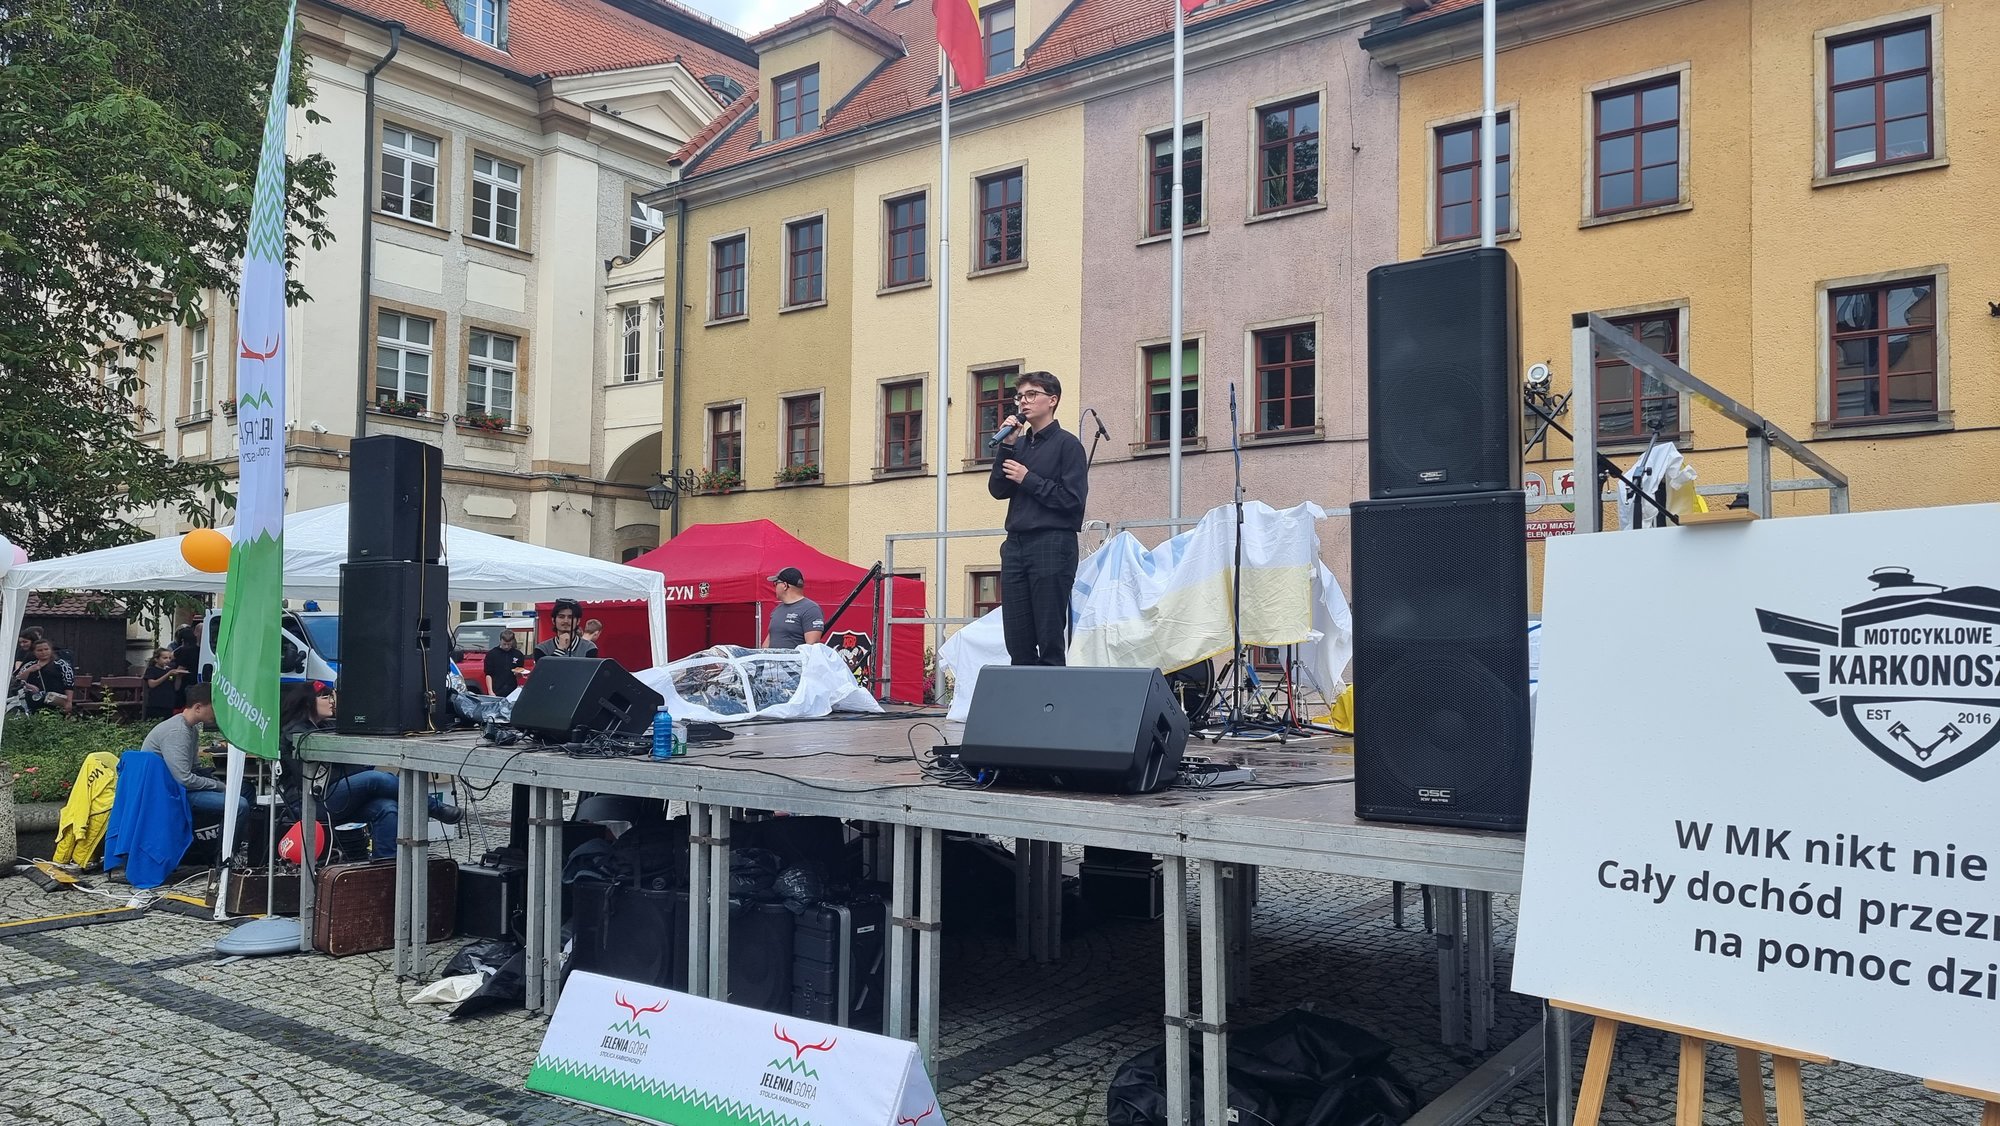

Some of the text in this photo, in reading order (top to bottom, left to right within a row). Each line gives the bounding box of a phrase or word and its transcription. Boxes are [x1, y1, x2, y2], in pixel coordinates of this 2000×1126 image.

[1526, 523, 1548, 533] RZĄD
[1526, 531, 1554, 539] ELENIA
[1864, 627, 1993, 645] MOTOCYKLOWE
[1866, 709, 1992, 724] EST 2016
[1418, 789, 1451, 798] QSC
[1674, 819, 1989, 882] W MK nikt nie
[1597, 860, 2000, 942] Cały dochód przez
[1693, 928, 1743, 959] na
[1757, 936, 1912, 987] pomoc
[600, 1035, 629, 1052] JELENIA
[760, 1072, 817, 1101] JELENIA GÓRA
